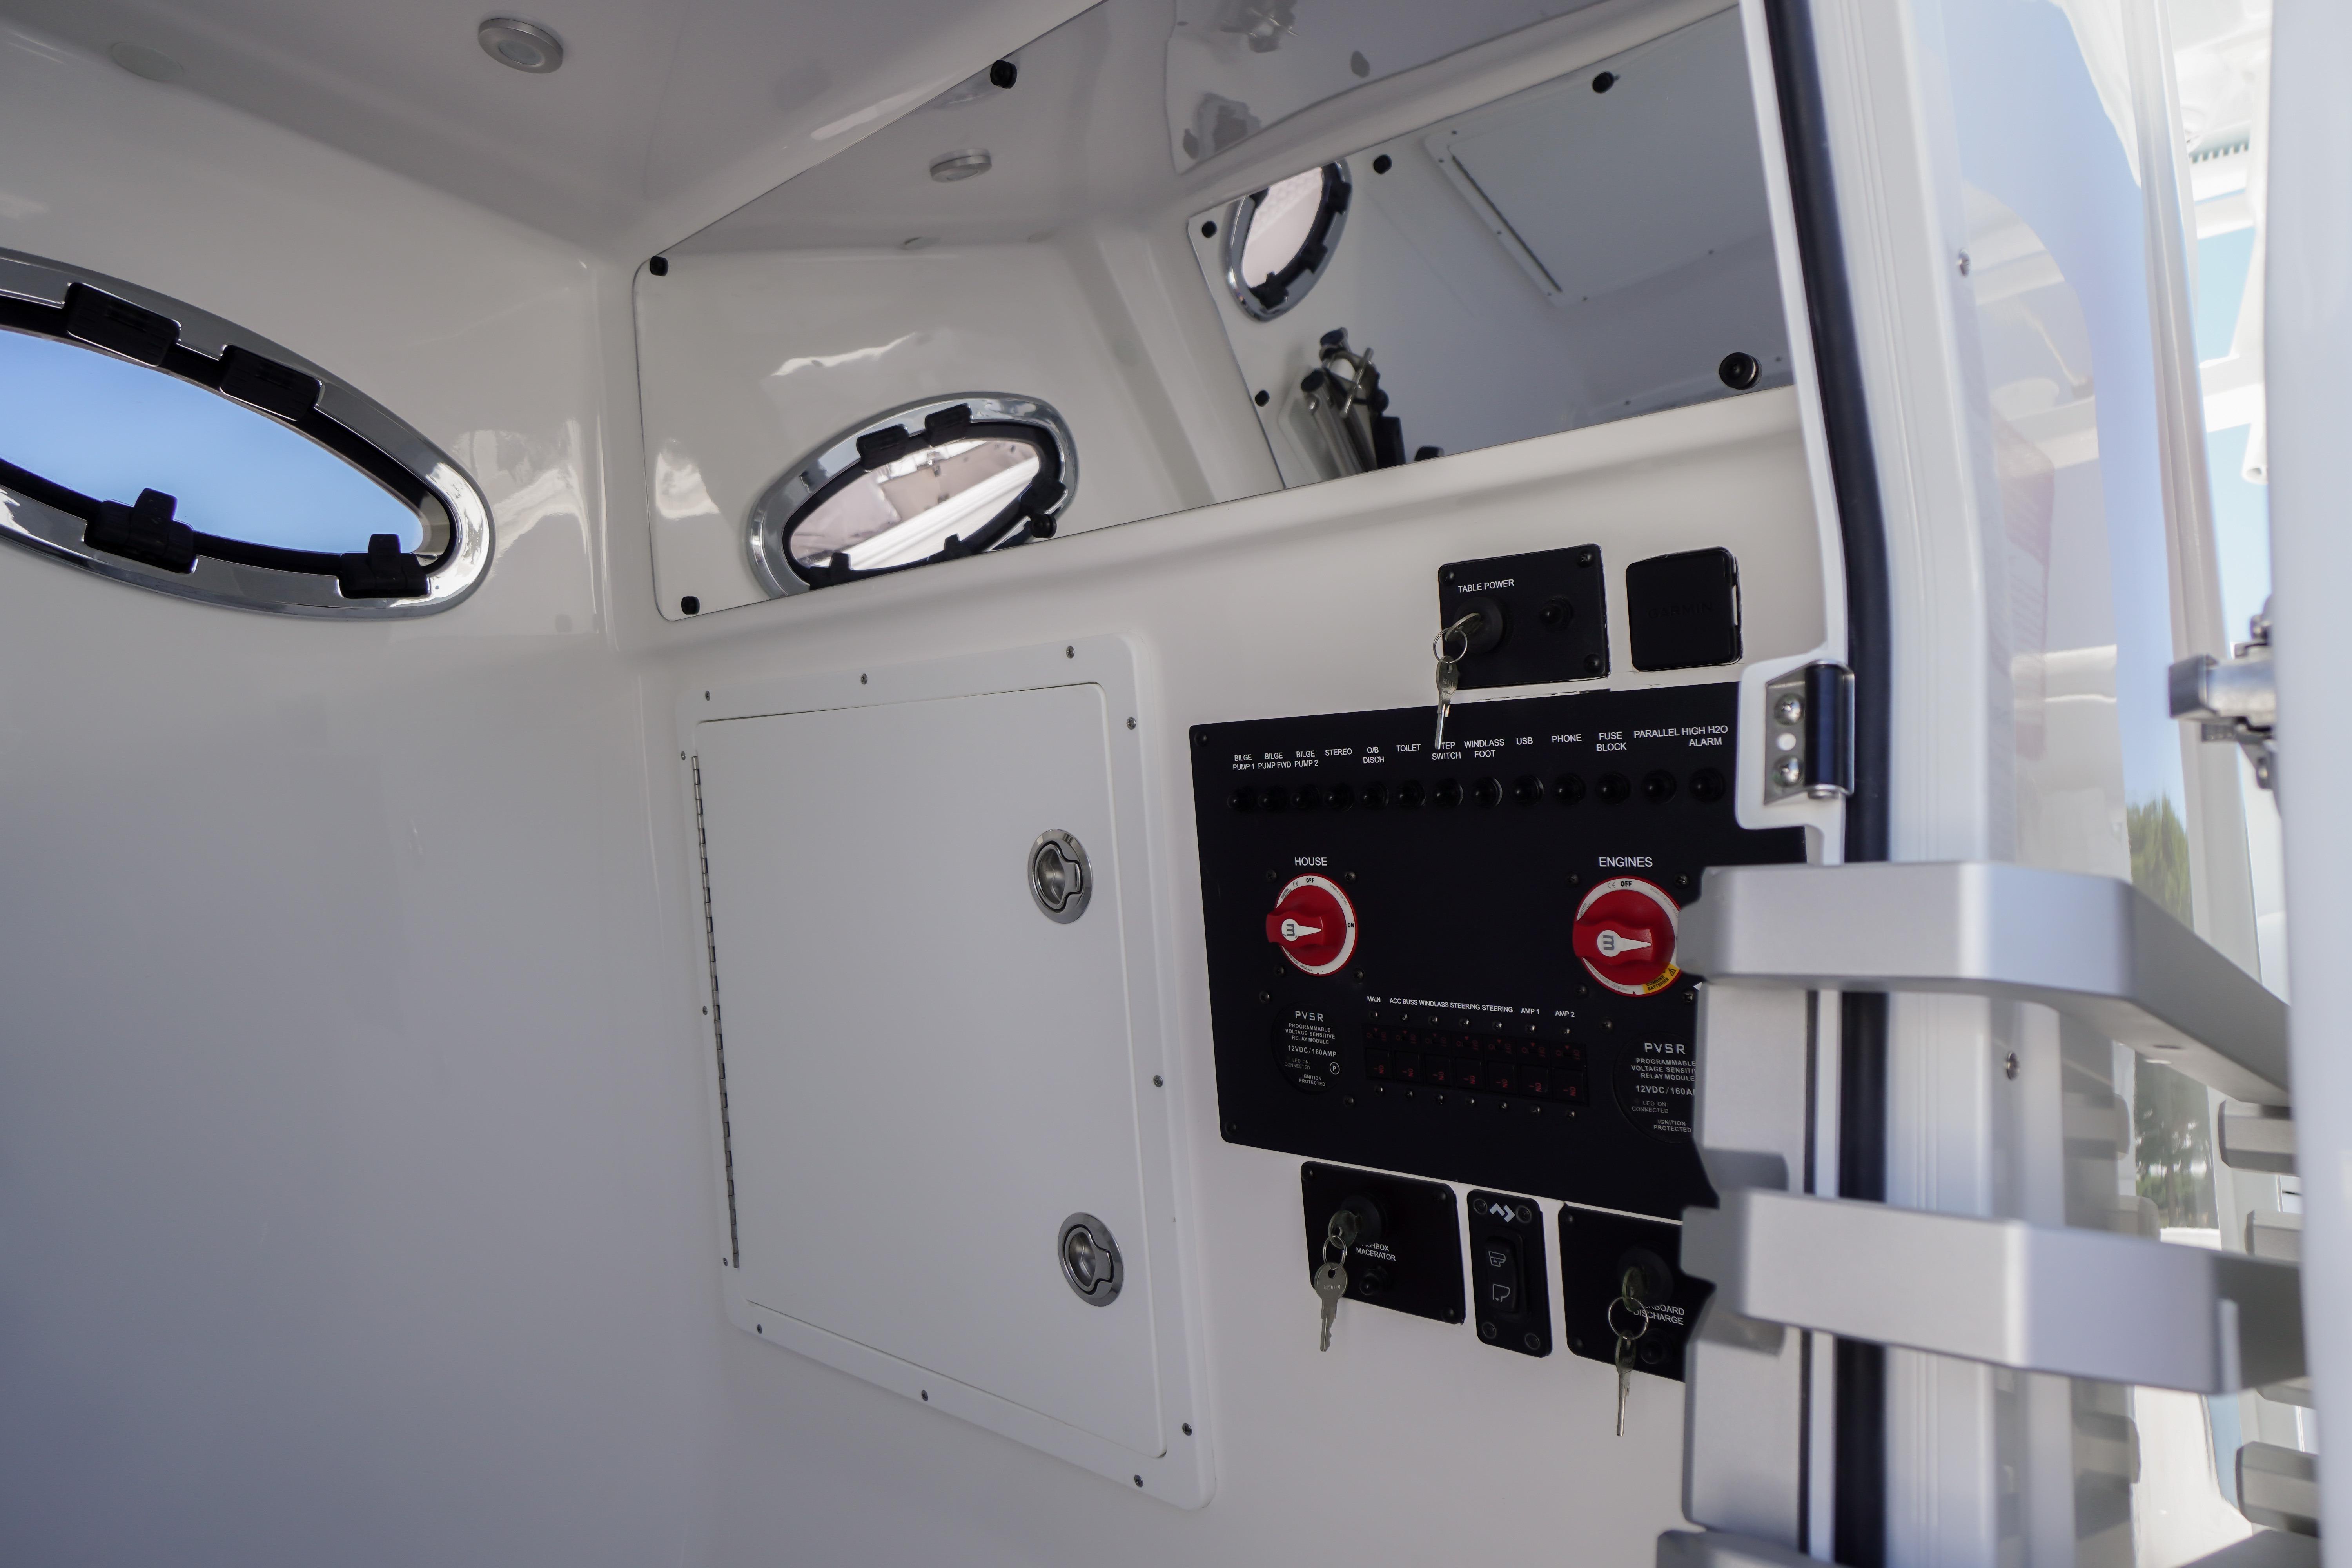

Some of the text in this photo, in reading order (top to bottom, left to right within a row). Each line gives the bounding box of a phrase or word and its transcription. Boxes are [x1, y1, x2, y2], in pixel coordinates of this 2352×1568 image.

[1458, 579, 1515, 593] TABLE POWER
[1648, 601, 1713, 618] GARMIN
[1599, 731, 1622, 740] FUSE
[1634, 725, 1728, 738] PARALLEL HIGH H2O
[1516, 737, 1533, 745] USB
[1552, 734, 1582, 743] PHONE
[1689, 737, 1722, 746] ALARM
[1396, 744, 1421, 752] TOILET
[1464, 739, 1505, 748] WINDLASS
[1597, 742, 1627, 751] BLOCK
[1325, 748, 1352, 756] STEREO
[1432, 751, 1461, 760] SWITCH
[1474, 750, 1496, 758] FOOT
[1363, 756, 1385, 764] DISCH
[1294, 857, 1328, 866] HOUSE
[1599, 857, 1653, 867] ENGINES
[1646, 975, 1665, 986] COMBINE
[1648, 977, 1669, 991] BATTERIES
[1419, 1000, 1449, 1008] WINDLASS
[1295, 1010, 1323, 1022] PVSR
[1289, 1023, 1331, 1033] PROGRAMMABLE
[1644, 1042, 1686, 1054] PVSR
[1636, 1058, 1696, 1067] PROGRAMMABLE
[1299, 1078, 1326, 1087] PROTECTED
[1362, 1243, 1389, 1252] HBOX
[1356, 1247, 1396, 1261] MACERATOR
